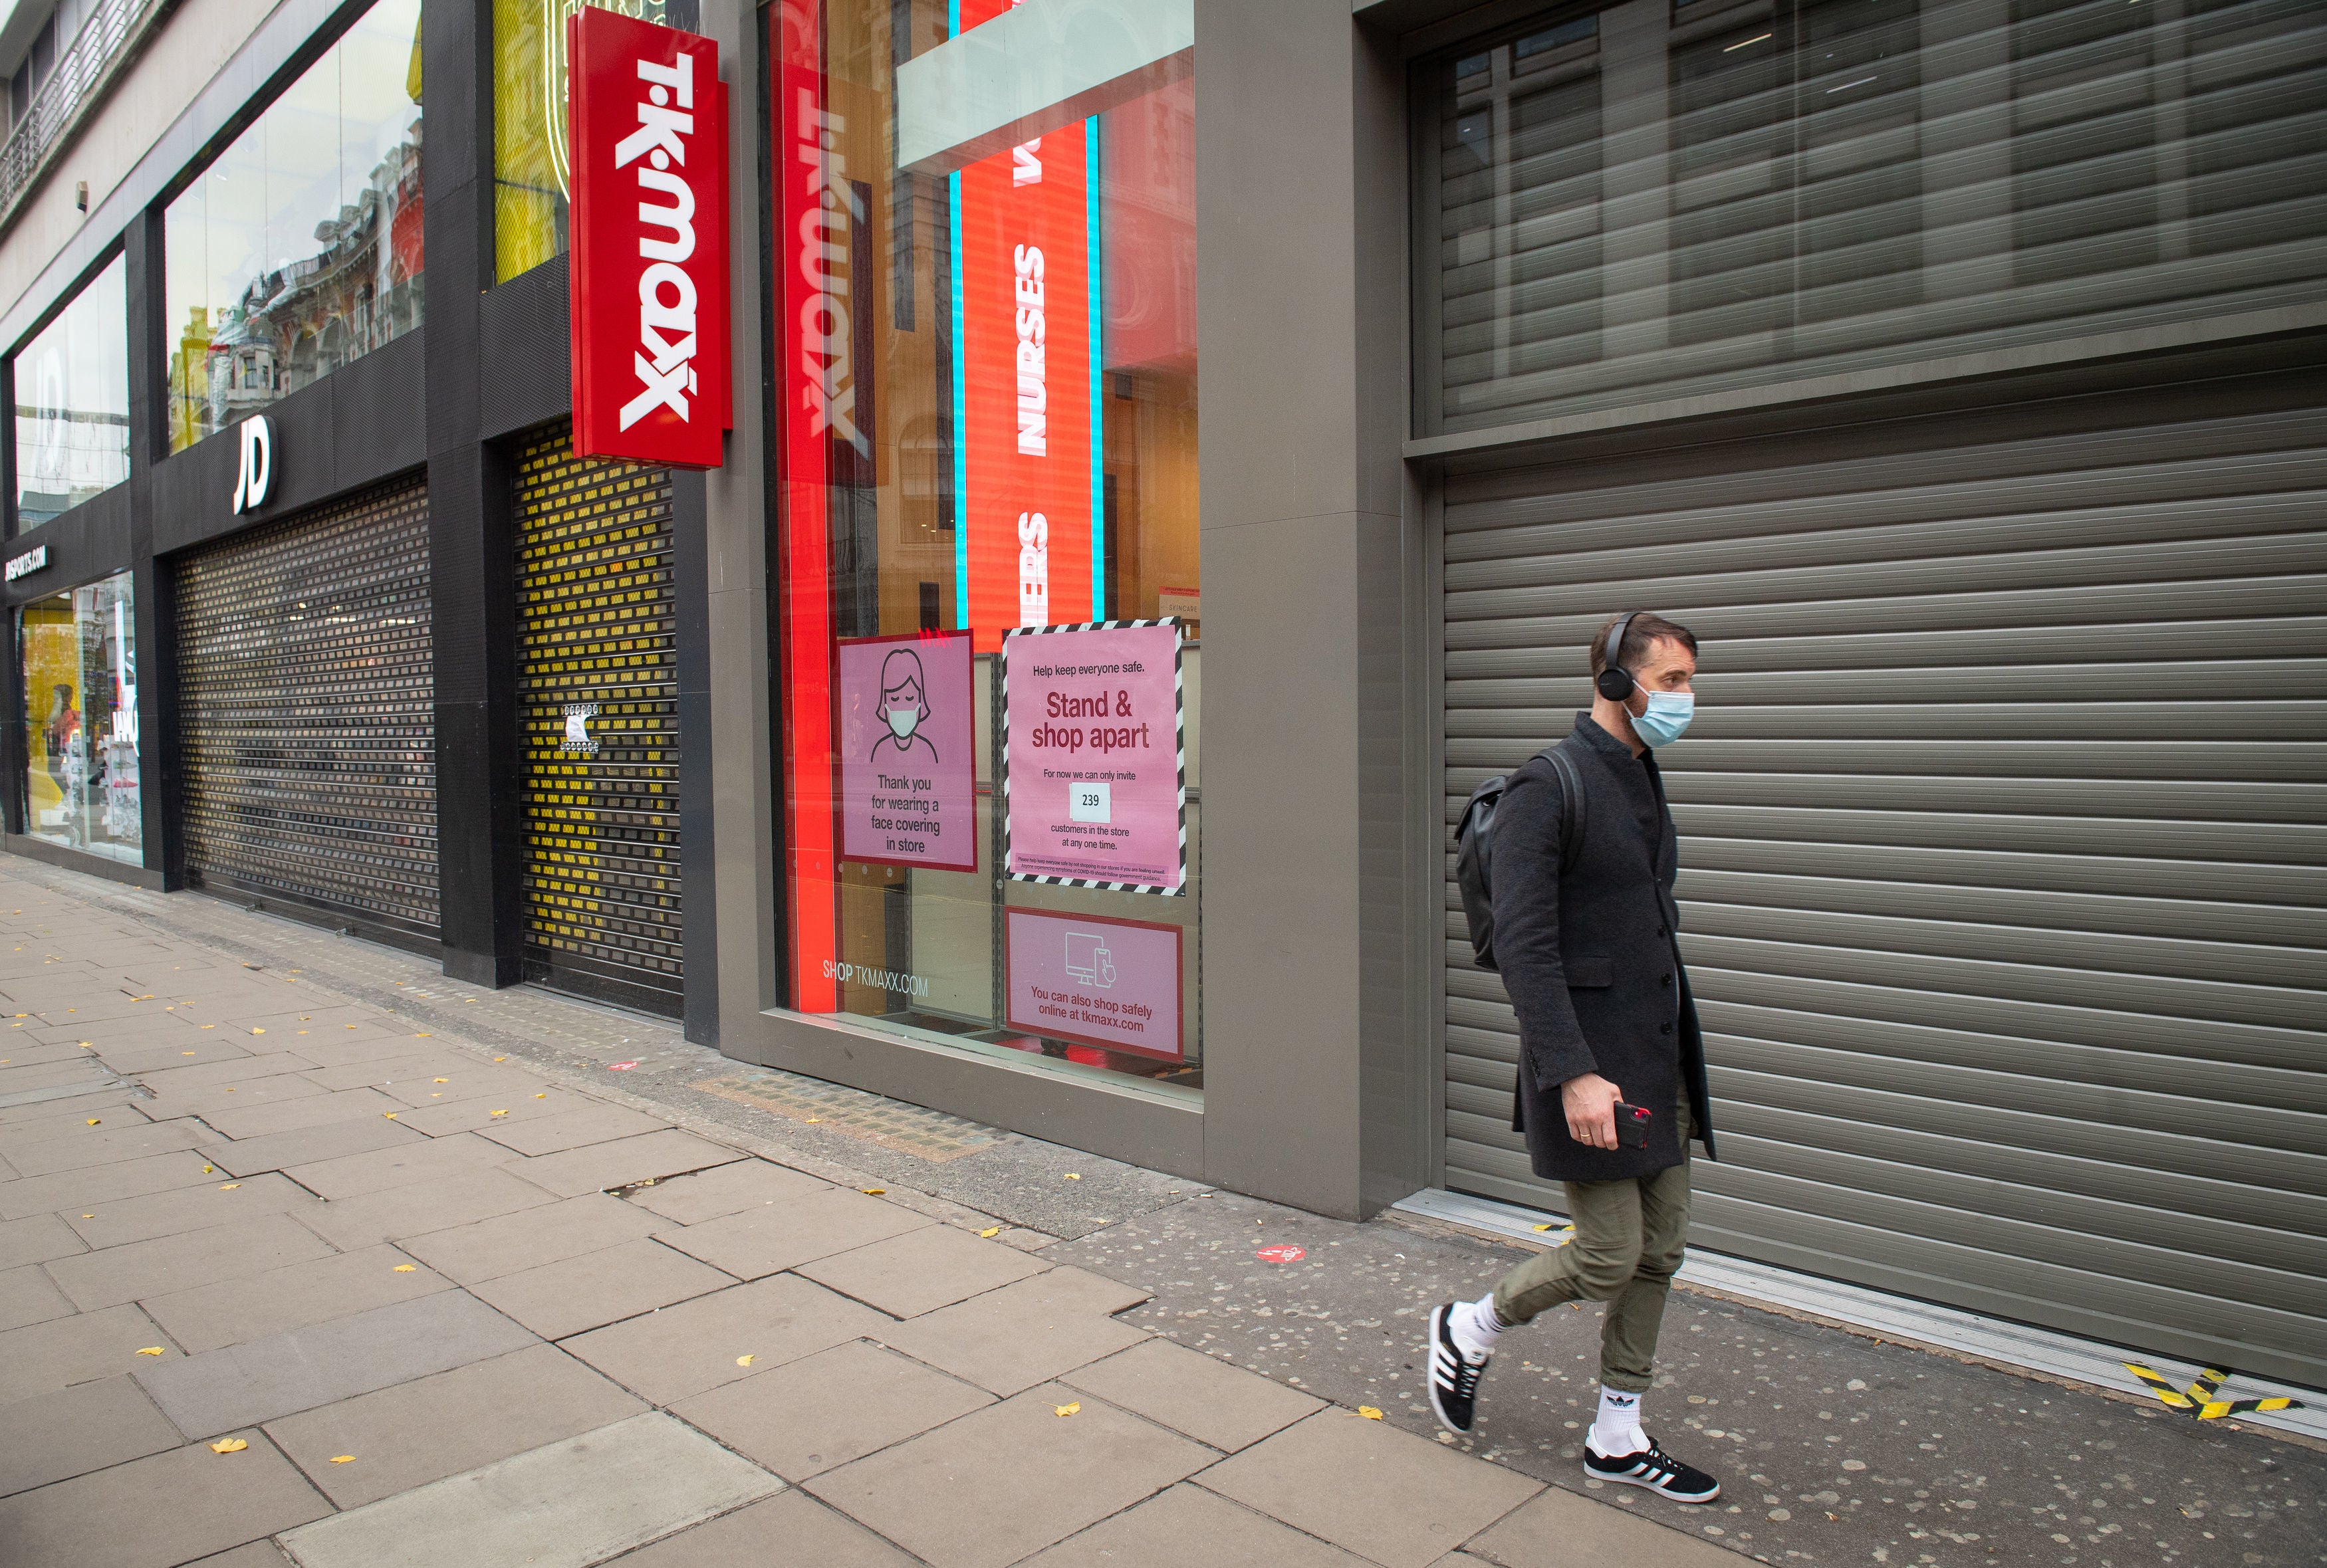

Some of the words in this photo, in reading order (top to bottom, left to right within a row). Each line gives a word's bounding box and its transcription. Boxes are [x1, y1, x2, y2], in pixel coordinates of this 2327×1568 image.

[1014, 243, 1047, 457] NURSES
[233, 414, 271, 516] JD
[5, 544, 47, 582] JDSPORTS.COM
[1033, 665, 1052, 678] Help
[1055, 665, 1076, 677] keep
[1078, 664, 1120, 676] everyone
[1122, 661, 1145, 673] safe.
[1046, 691, 1108, 718] Stand
[1116, 690, 1132, 717] &
[1032, 722, 1084, 754] shop
[1090, 723, 1150, 754] apart
[878, 774, 910, 790] Thank
[912, 778, 931, 793] you
[1044, 769, 1055, 778] For
[1100, 771, 1115, 781] only
[1116, 771, 1136, 780] invite
[872, 794, 886, 809] for
[888, 796, 929, 814] wearing
[932, 800, 939, 812] a
[1082, 794, 1099, 806] 239
[872, 815, 892, 830] face
[896, 818, 940, 836] covering
[1050, 824, 1087, 834] customers
[1089, 826, 1096, 834] in
[1097, 826, 1108, 836] the
[1110, 828, 1130, 837] store
[886, 836, 896, 850] in
[898, 838, 925, 853] store
[1062, 838, 1069, 847] at
[1070, 840, 1082, 849] any
[1099, 840, 1118, 850] time.
[822, 959, 853, 982] SHOP
[855, 965, 928, 997] TKMAXX.COM
[1031, 986, 1048, 1000] You
[1051, 992, 1068, 1003] can
[1071, 994, 1091, 1007] also
[1094, 998, 1119, 1014] shop
[1122, 1004, 1152, 1020] safely
[1039, 1004, 1066, 1018] online
[1070, 1009, 1079, 1020] at
[1082, 1010, 1144, 1032] tkmaxx.com
